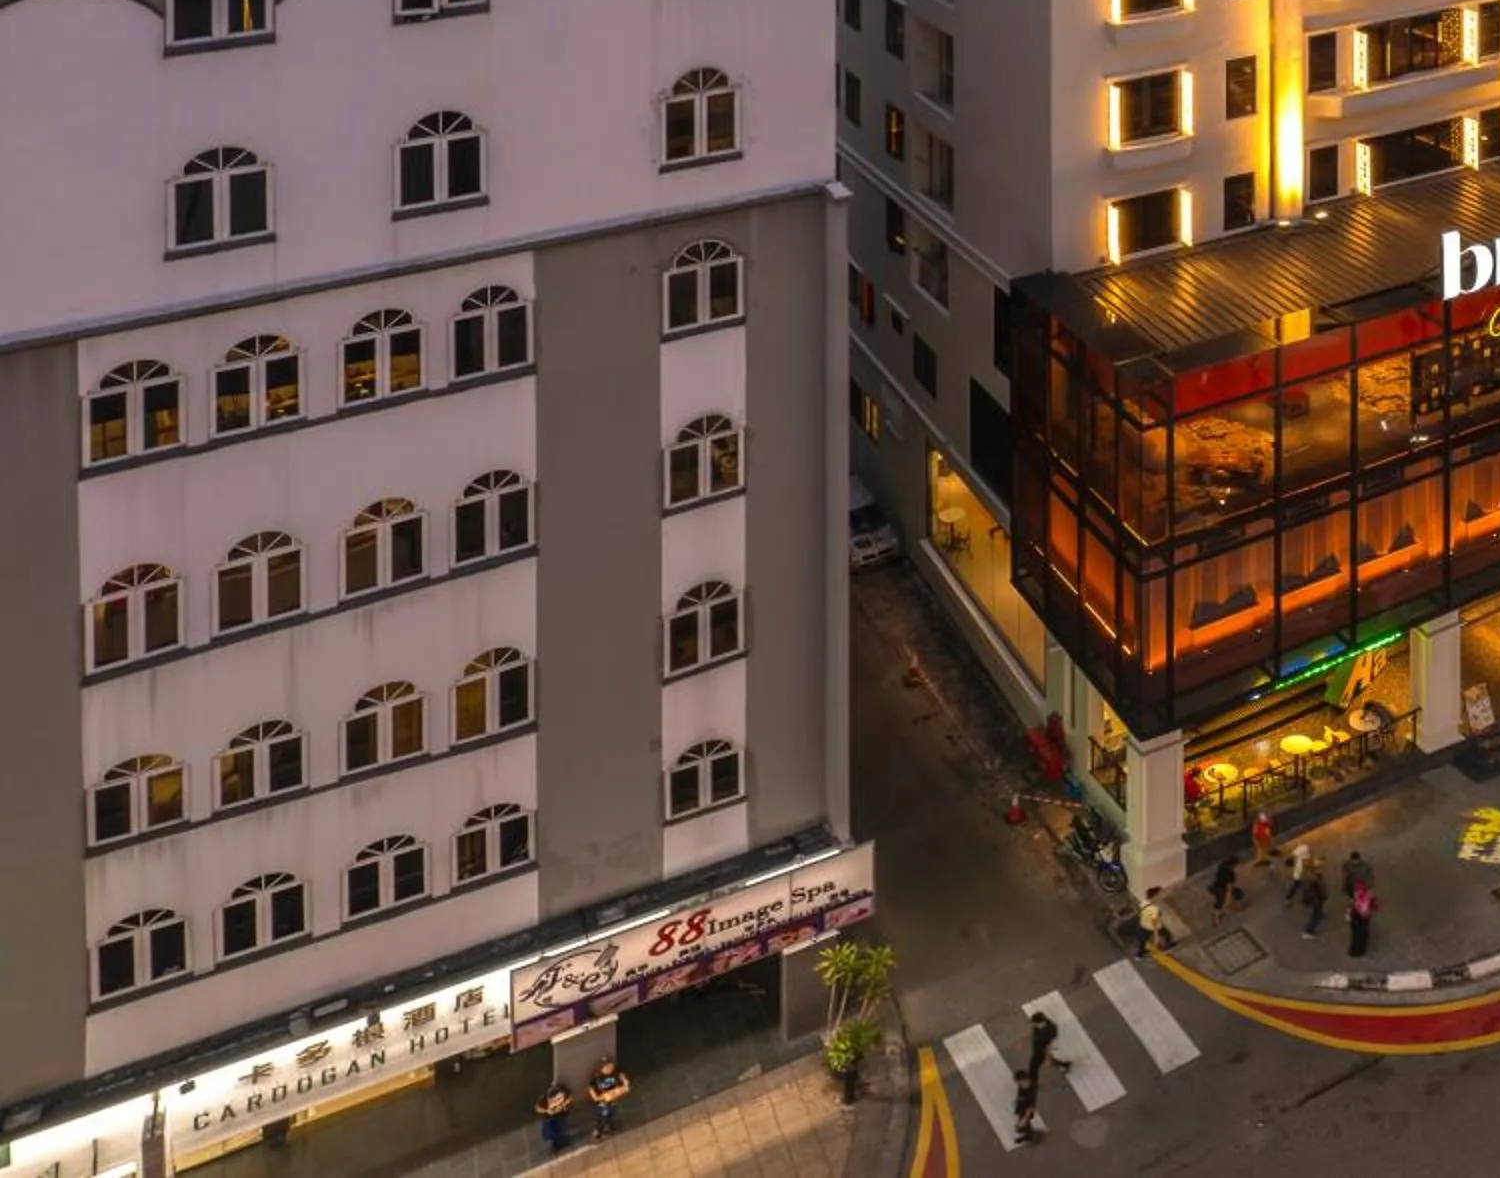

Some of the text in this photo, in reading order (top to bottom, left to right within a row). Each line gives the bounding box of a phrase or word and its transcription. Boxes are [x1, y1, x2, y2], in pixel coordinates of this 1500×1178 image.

[648, 907, 711, 958] 88
[707, 899, 784, 936] Image
[791, 880, 836, 906] Spa
[193, 1002, 511, 1133] CARDOGAN HOTEL
